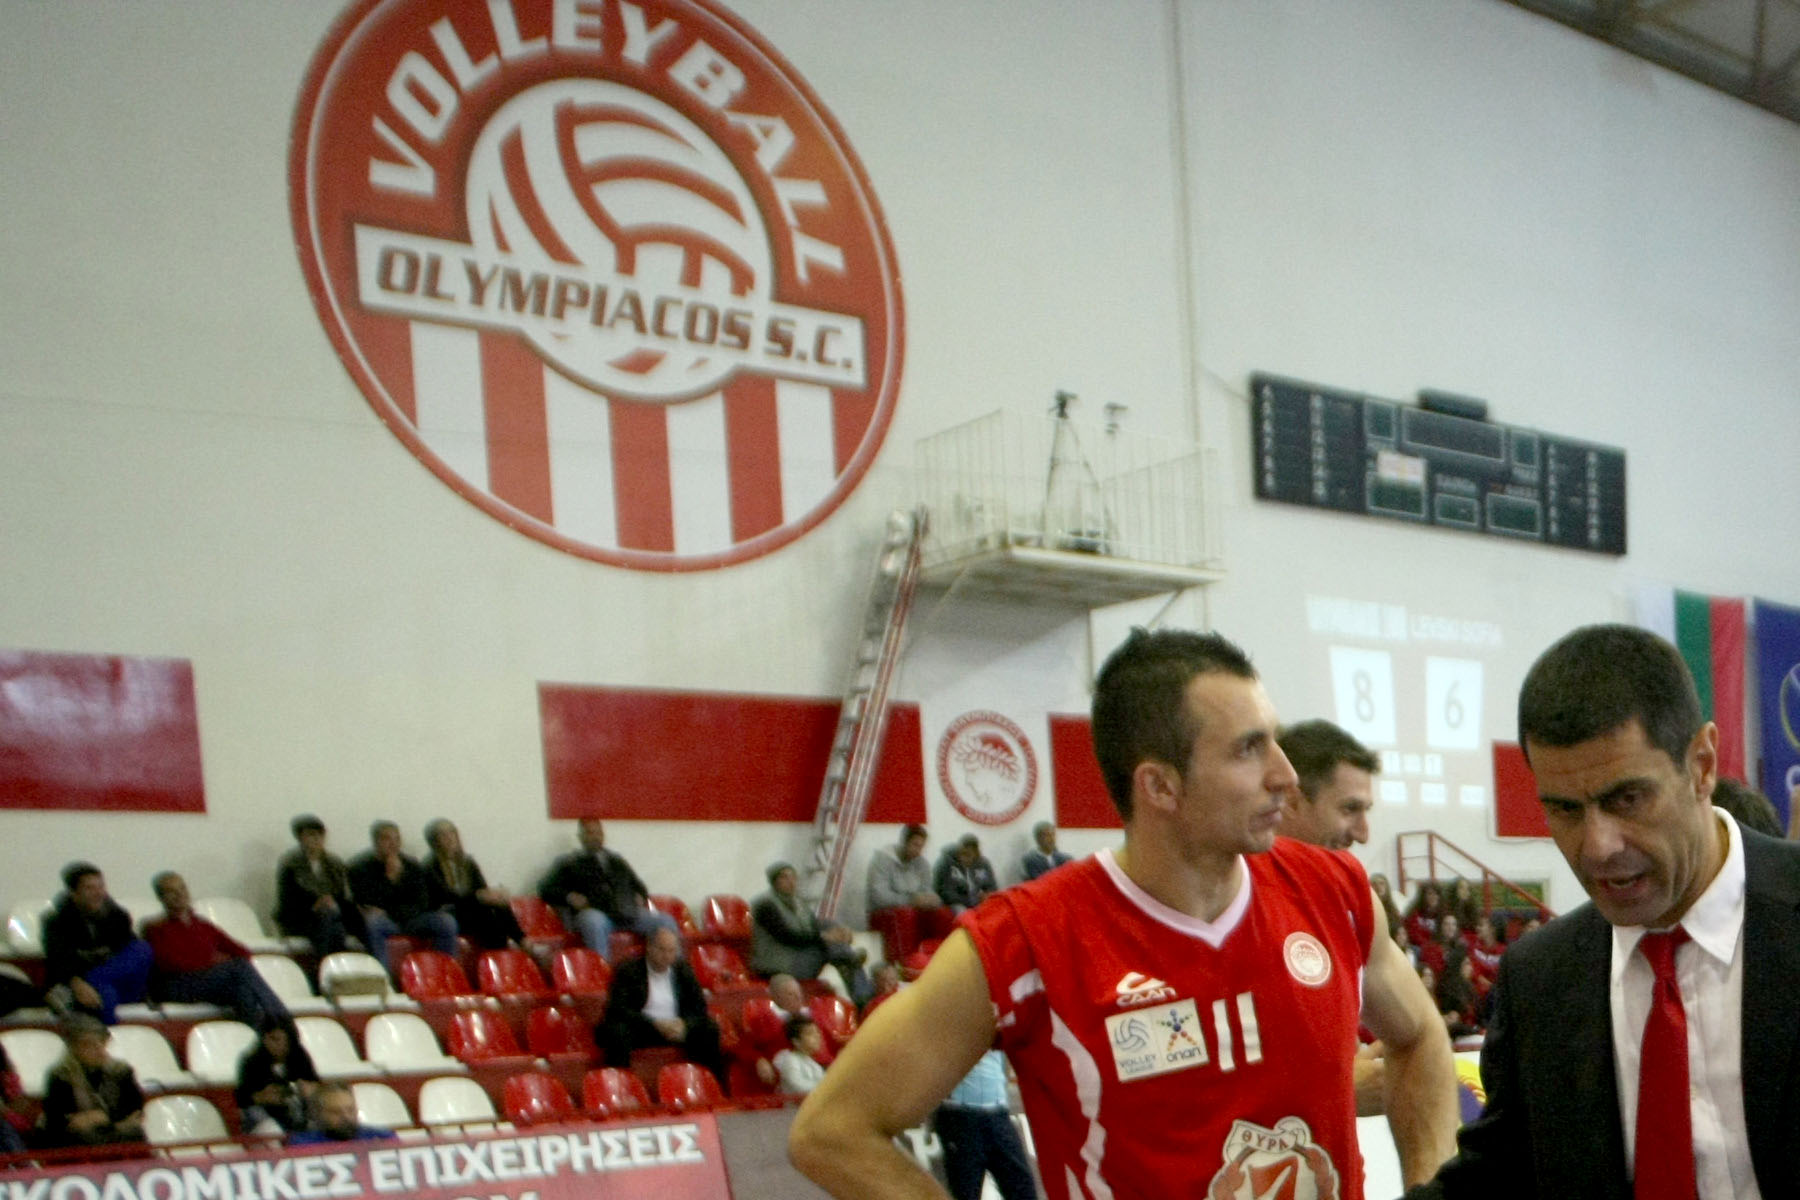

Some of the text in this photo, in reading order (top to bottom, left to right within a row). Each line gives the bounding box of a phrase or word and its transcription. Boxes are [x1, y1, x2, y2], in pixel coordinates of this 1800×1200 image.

[368, 0, 846, 284] VOLLEYBALL
[374, 243, 855, 370] OLYMPIACOS S.C.
[1352, 668, 1376, 724] 8
[1444, 679, 1465, 730] 6
[1212, 991, 1264, 1073] 11
[368, 1122, 705, 1192] ΕΠΙΧΕΙΡΗΣΕΙΣ
